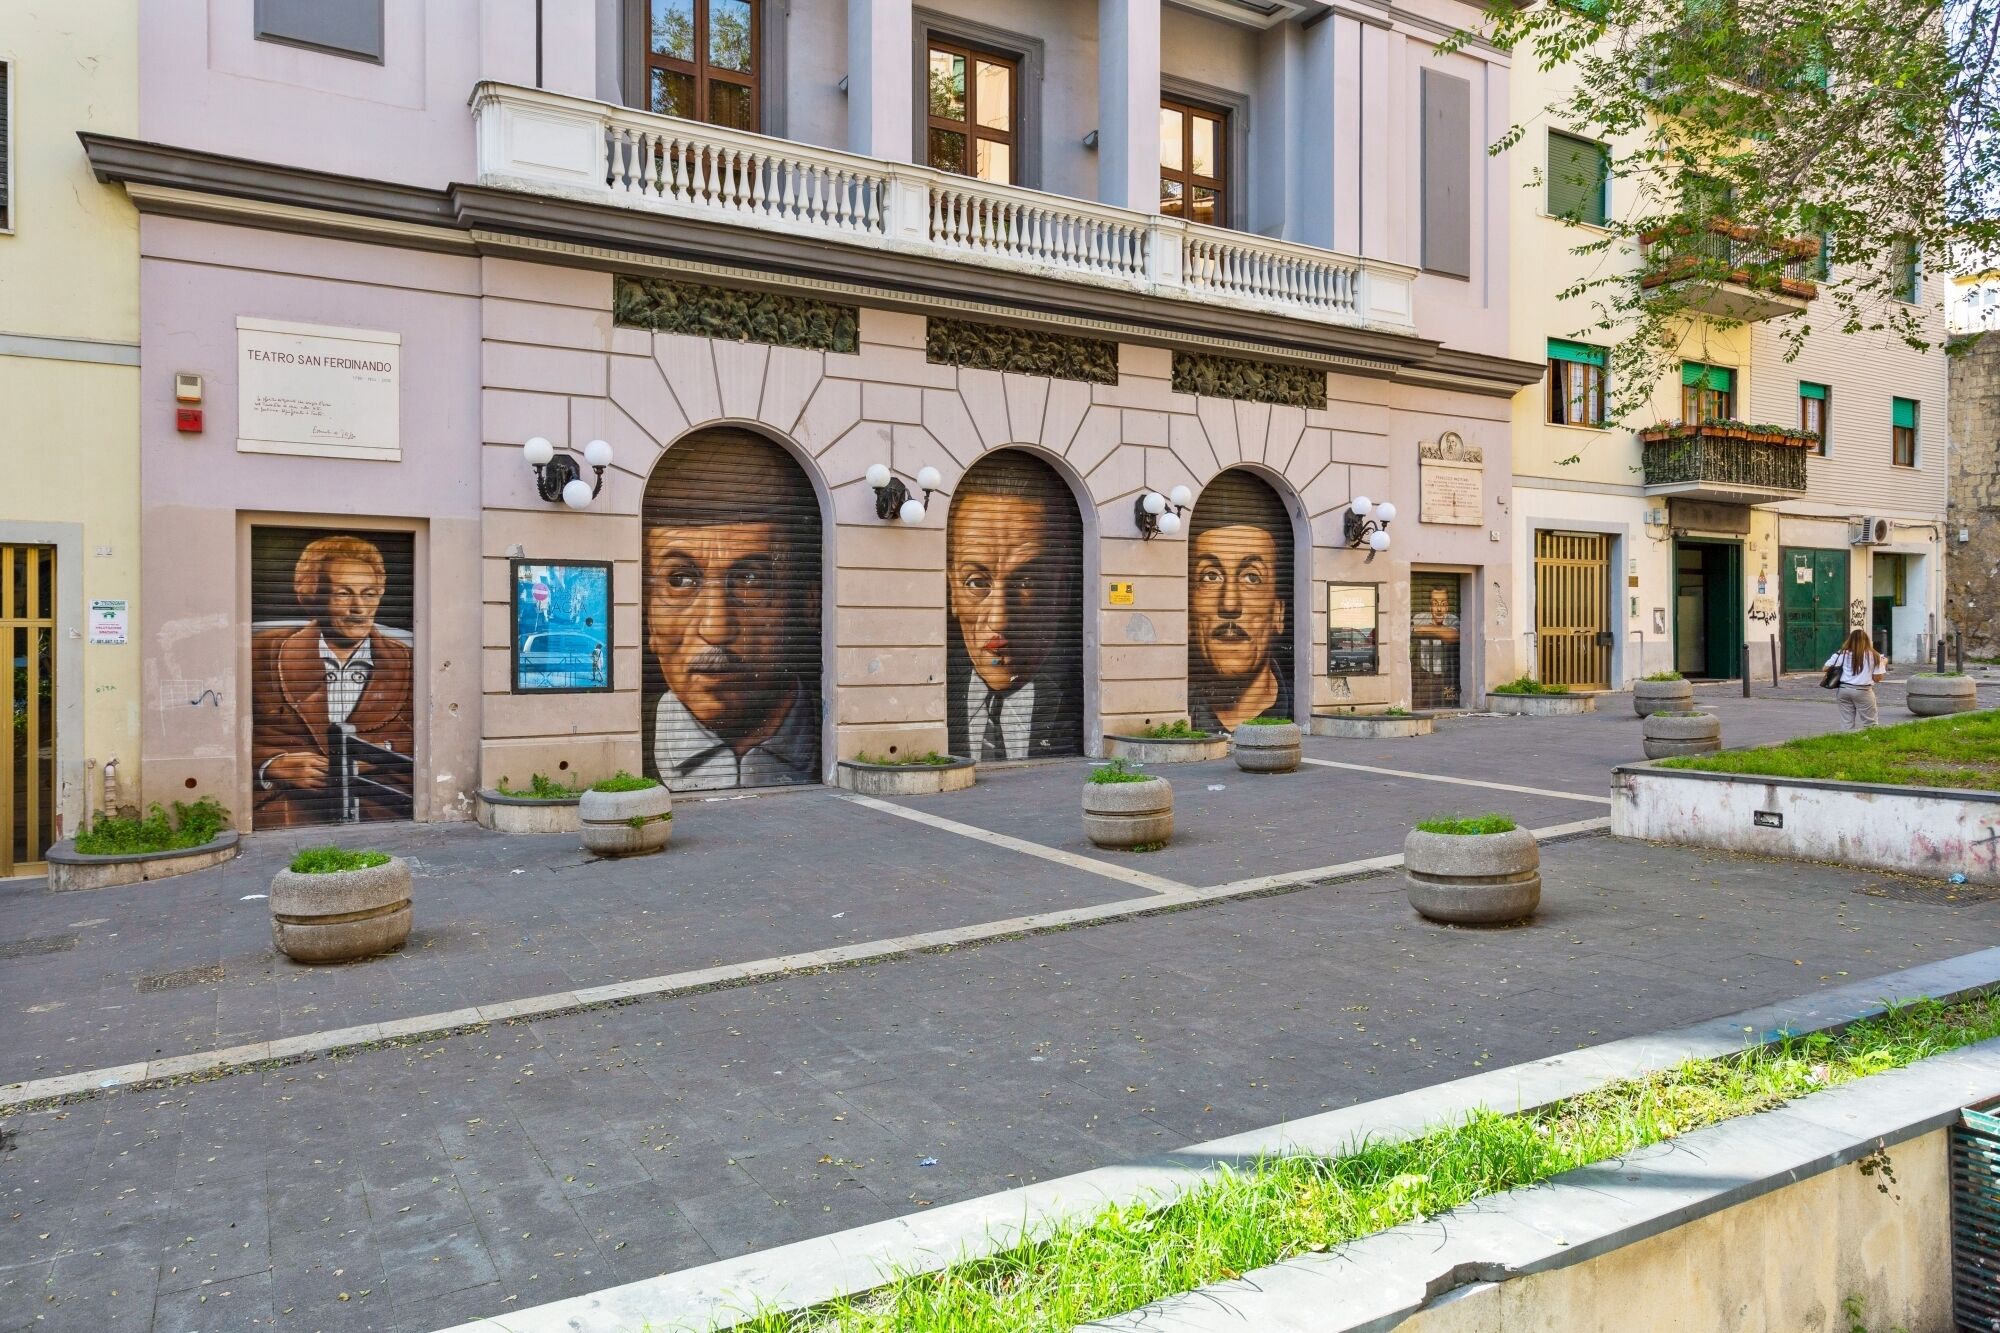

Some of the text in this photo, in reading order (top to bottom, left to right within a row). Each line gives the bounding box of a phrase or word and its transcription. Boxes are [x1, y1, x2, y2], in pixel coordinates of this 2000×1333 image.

[248, 349, 392, 373] TEATRO SAN FERDINANDO
